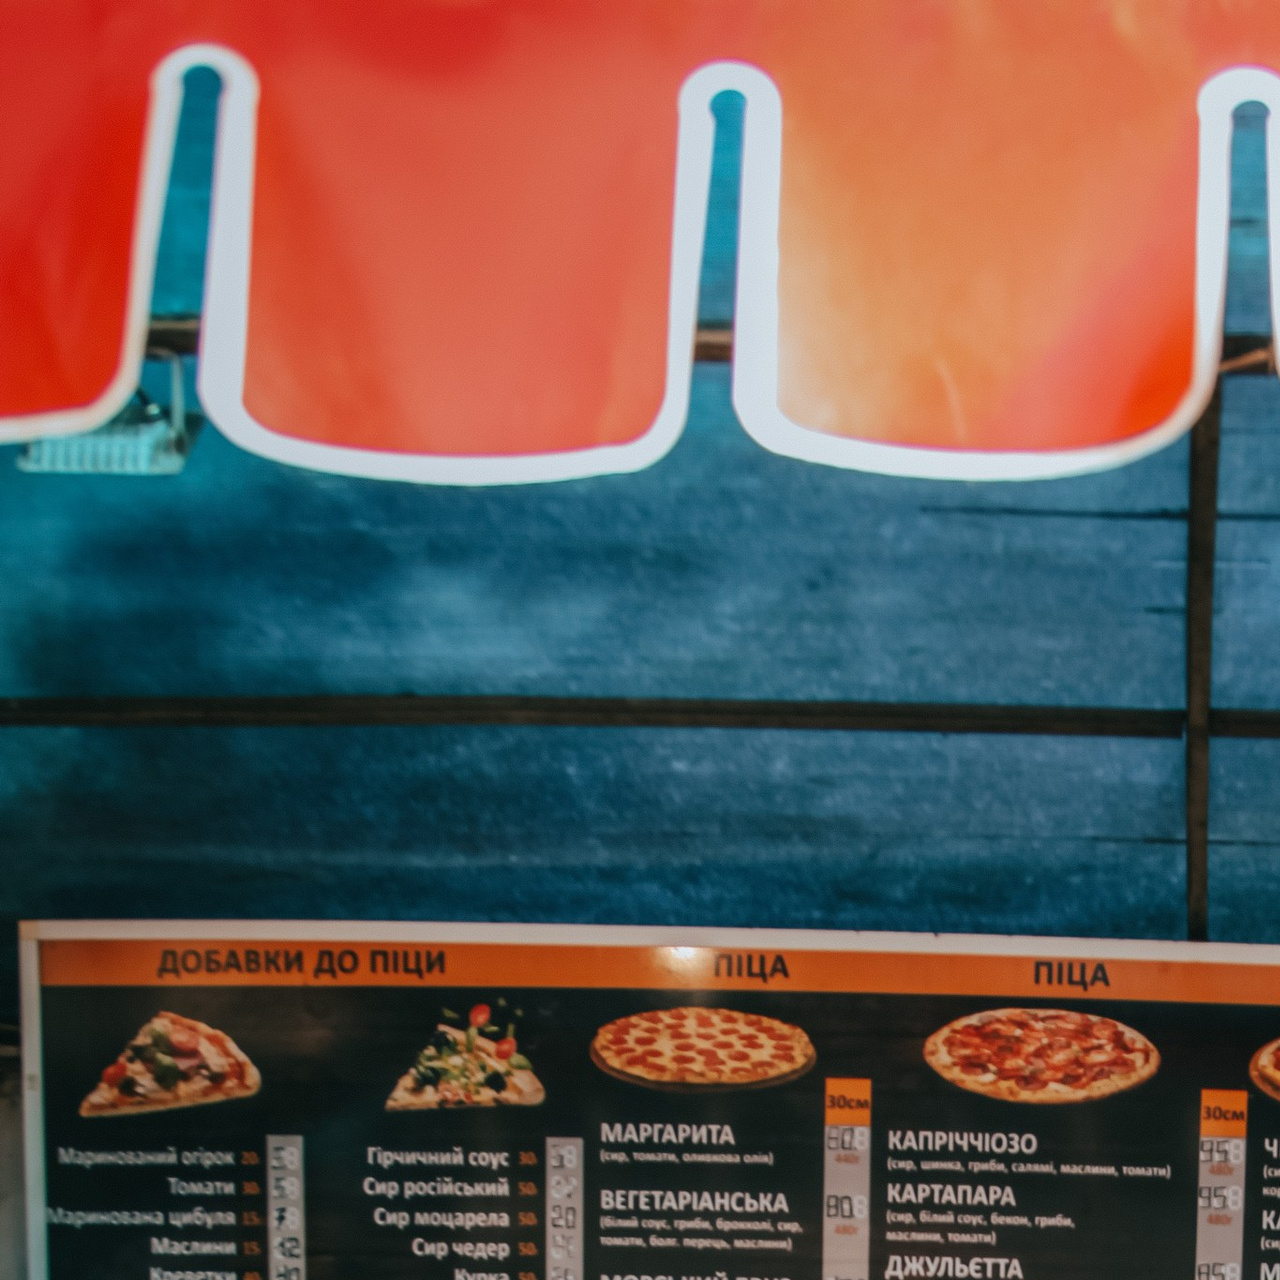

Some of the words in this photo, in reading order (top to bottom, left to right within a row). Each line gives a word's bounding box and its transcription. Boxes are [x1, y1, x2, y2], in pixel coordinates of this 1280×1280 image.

[157, 949, 303, 979] ДОБАВКИ
[314, 950, 359, 979] ДО
[369, 950, 446, 980] ПІЦИ
[714, 953, 789, 983] ПІЦА
[1034, 960, 1110, 991] ПІЦА
[1203, 1106, 1245, 1121] 30см
[601, 1123, 735, 1145] МАРГАРИТА
[888, 1130, 1038, 1154] КАПРІЧЧІОЗО
[367, 1147, 464, 1169] Гірчичний
[468, 1150, 509, 1170] соус
[167, 1177, 235, 1195] Томати
[363, 1177, 399, 1200] Сир
[404, 1177, 509, 1200] російський
[887, 1183, 1016, 1206] КАРТАПАРА
[600, 1190, 789, 1213] ВЕГЕТАРІАНСЬКА
[374, 1207, 410, 1230] Сир
[414, 1211, 509, 1230] моцарела
[151, 1237, 236, 1255] Маслини
[412, 1238, 448, 1260] Сир
[452, 1241, 510, 1260] чедер
[885, 1255, 1024, 1280] ДЖУЛЬЄТТА
